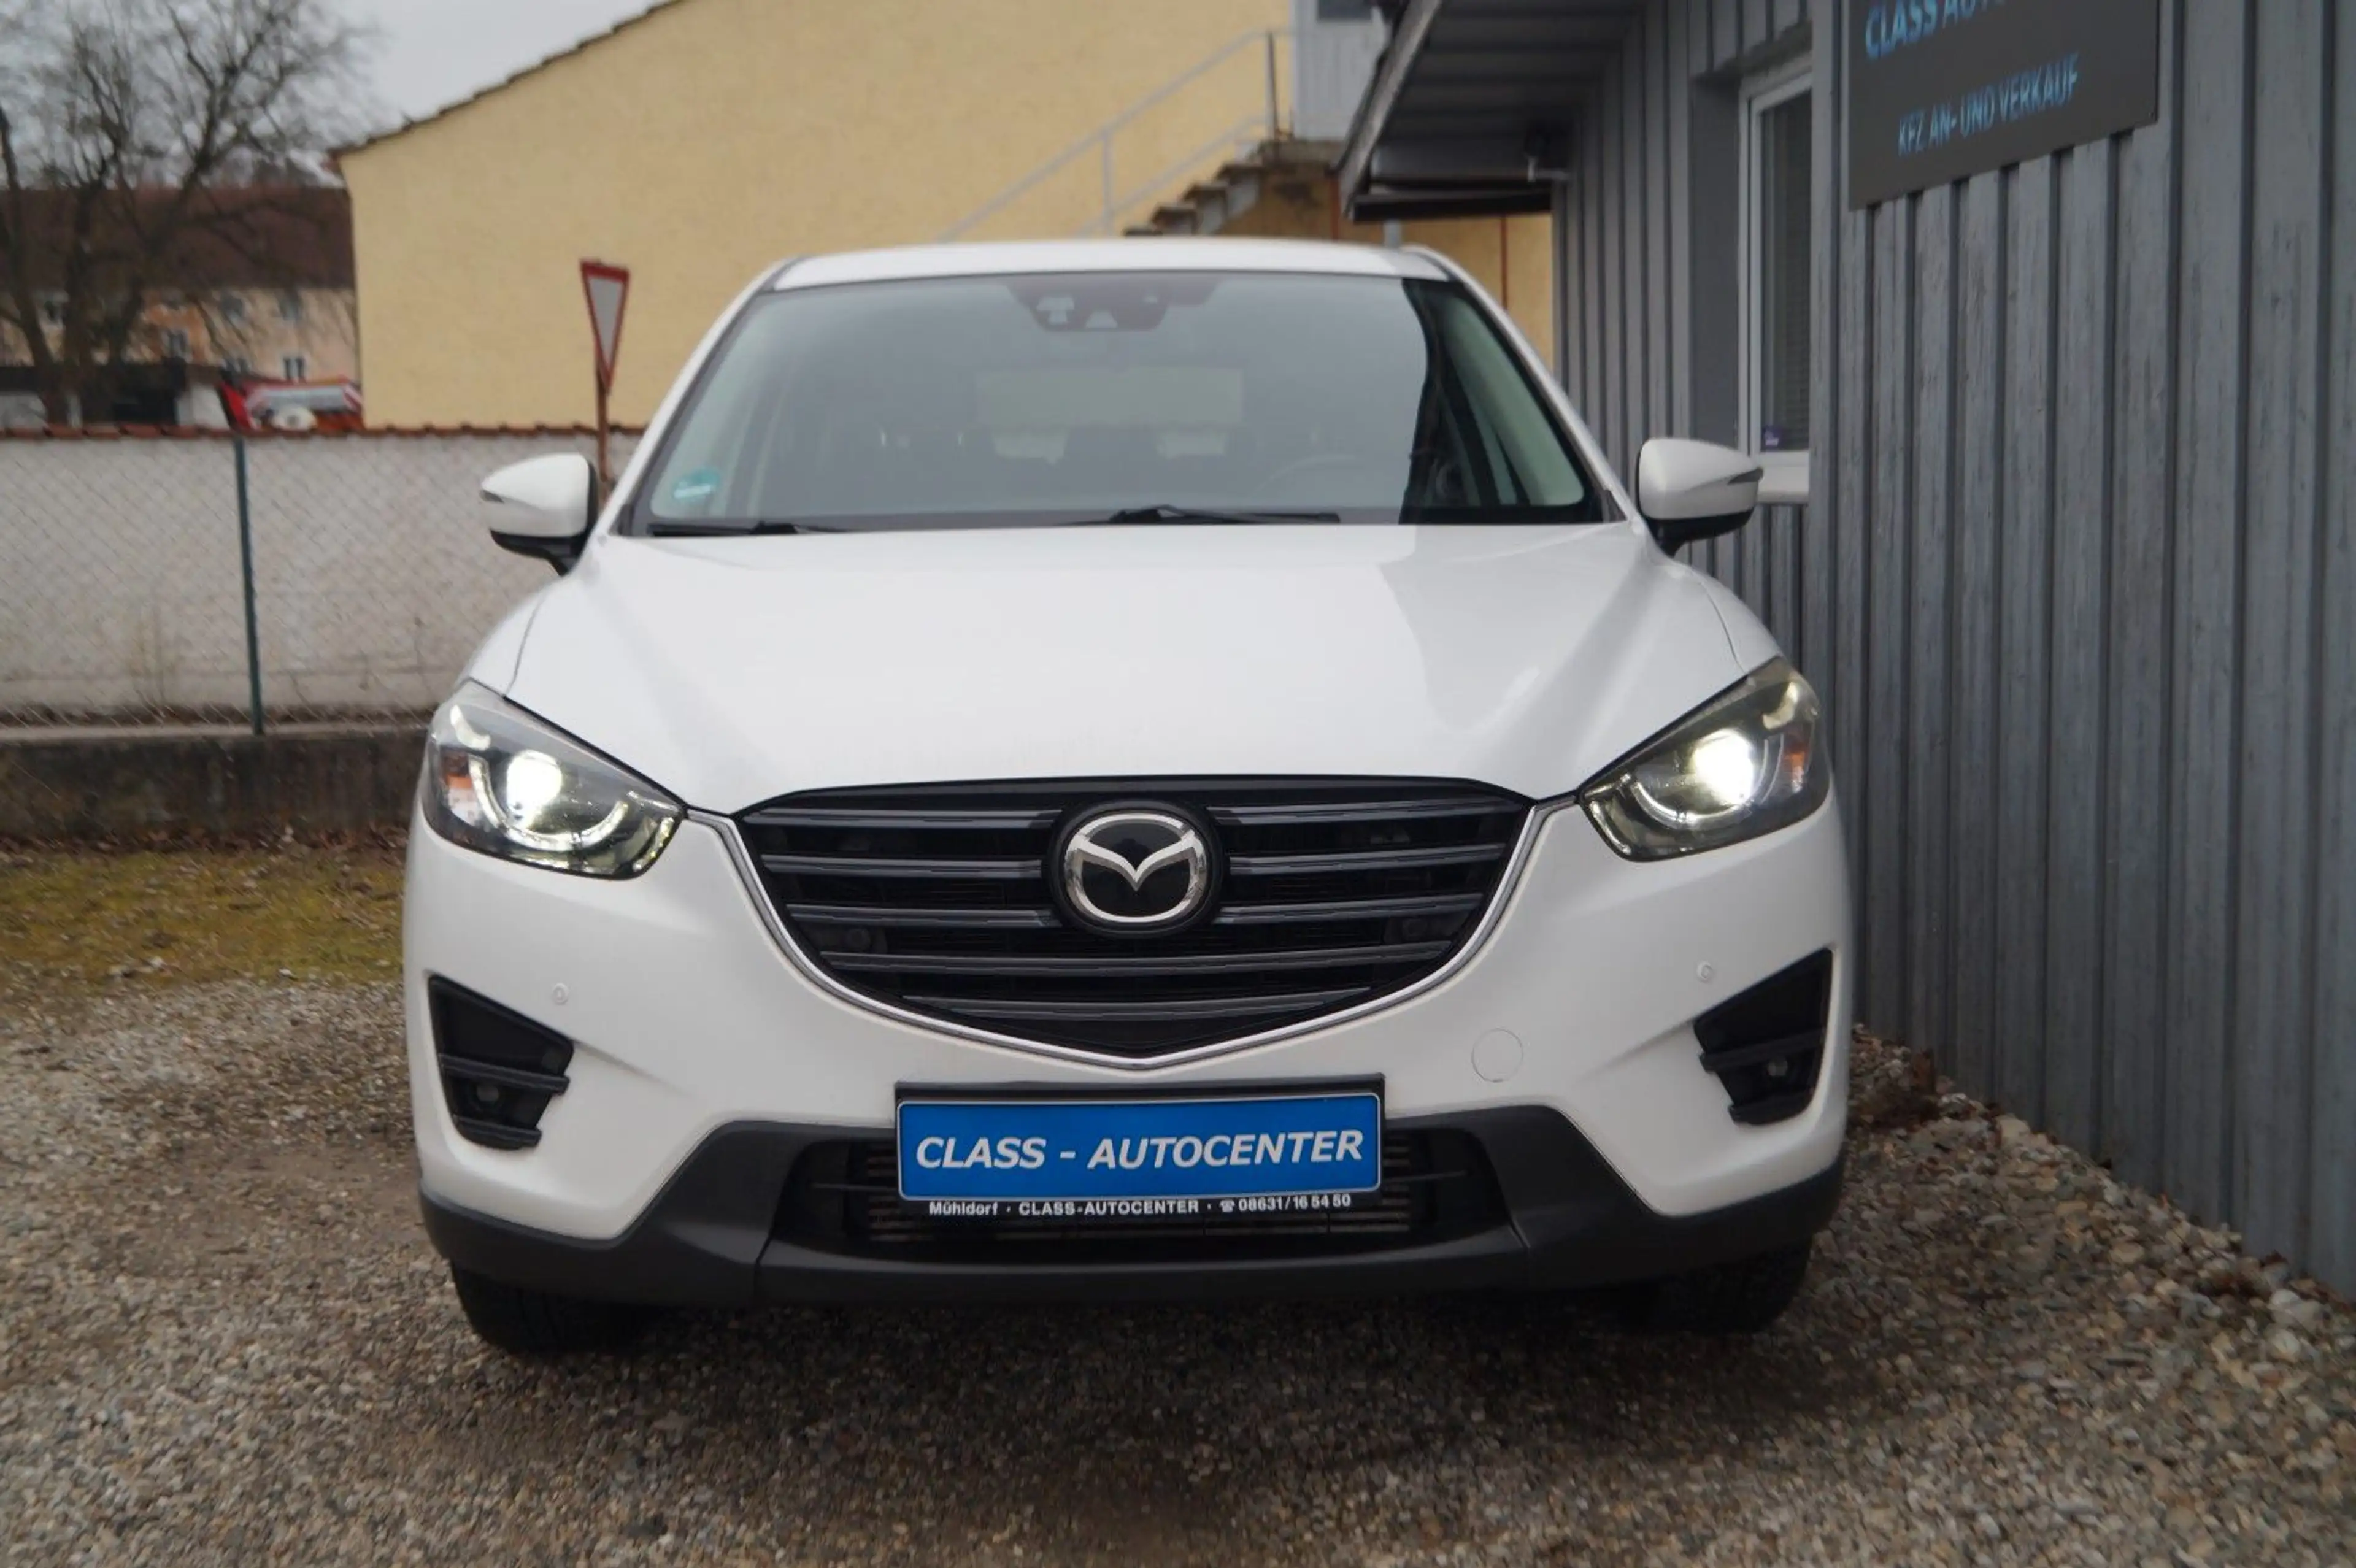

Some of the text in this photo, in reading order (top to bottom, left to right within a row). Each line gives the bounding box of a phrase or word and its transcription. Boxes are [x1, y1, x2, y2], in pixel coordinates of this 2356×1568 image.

[1865, 0, 1938, 60] CLASS
[1898, 109, 1925, 157] KFZ
[1960, 85, 1995, 138] UND
[1999, 52, 2079, 123] VERKAUF
[916, 1137, 1047, 1169] CLASS
[1087, 1129, 1363, 1170] AUTOCENTER
[929, 1201, 998, 1216] Mühldorf
[1019, 1199, 1199, 1216] CLASS-AUTOCENTER
